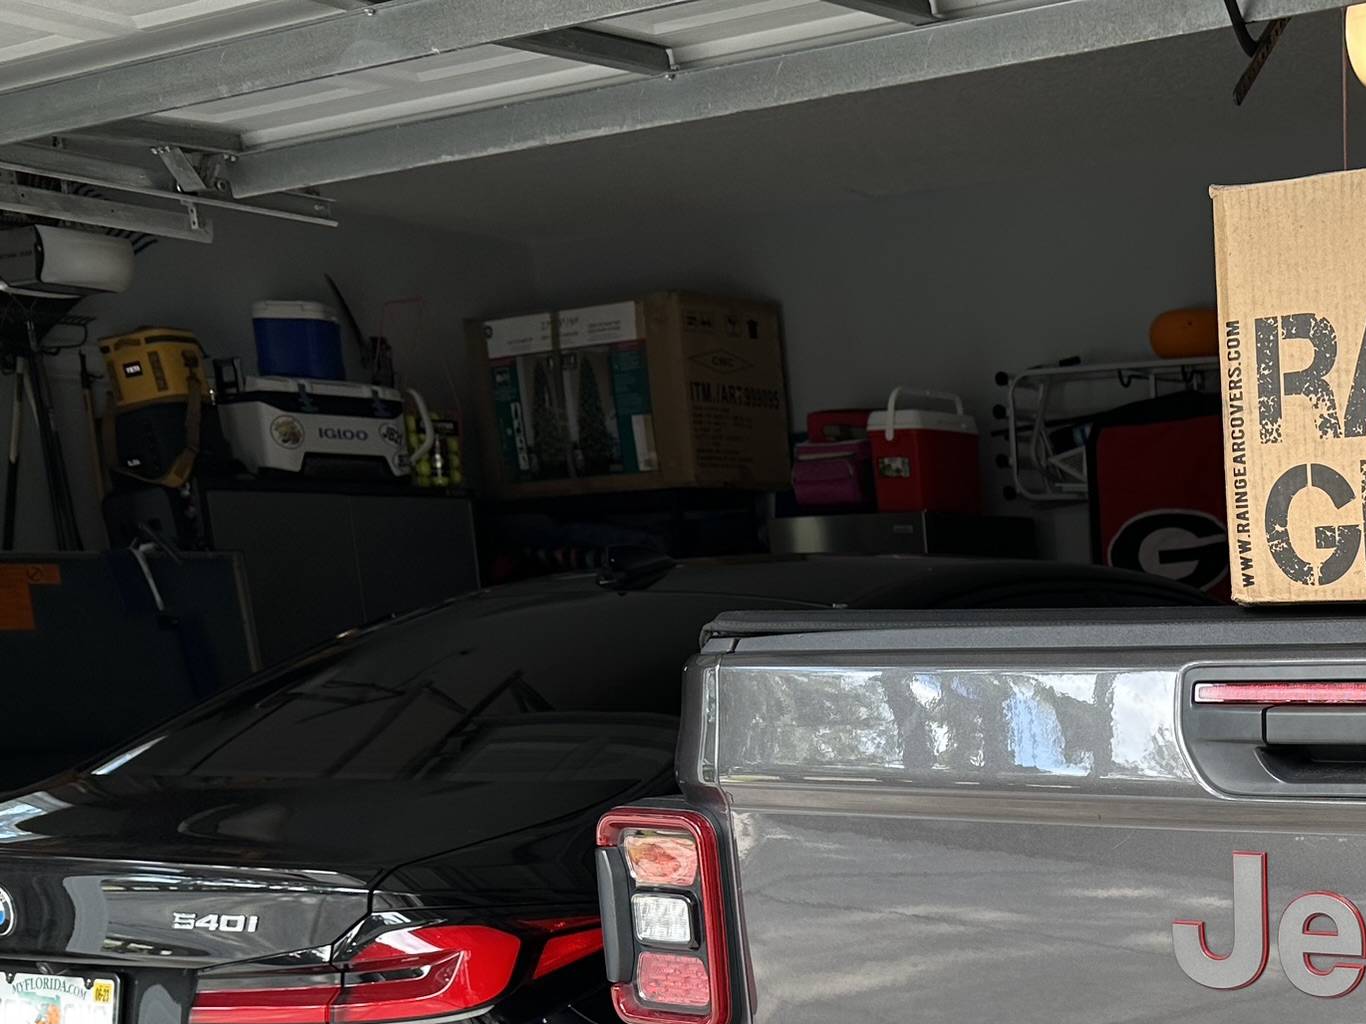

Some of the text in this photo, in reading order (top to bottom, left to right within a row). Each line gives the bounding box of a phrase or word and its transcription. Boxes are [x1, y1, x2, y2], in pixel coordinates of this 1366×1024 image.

[318, 427, 370, 441] IGLOO
[1226, 320, 1255, 588] WWW.RAINGEARCOVERS.COM
[11, 976, 88, 1001] MYFLORIDA.COM
